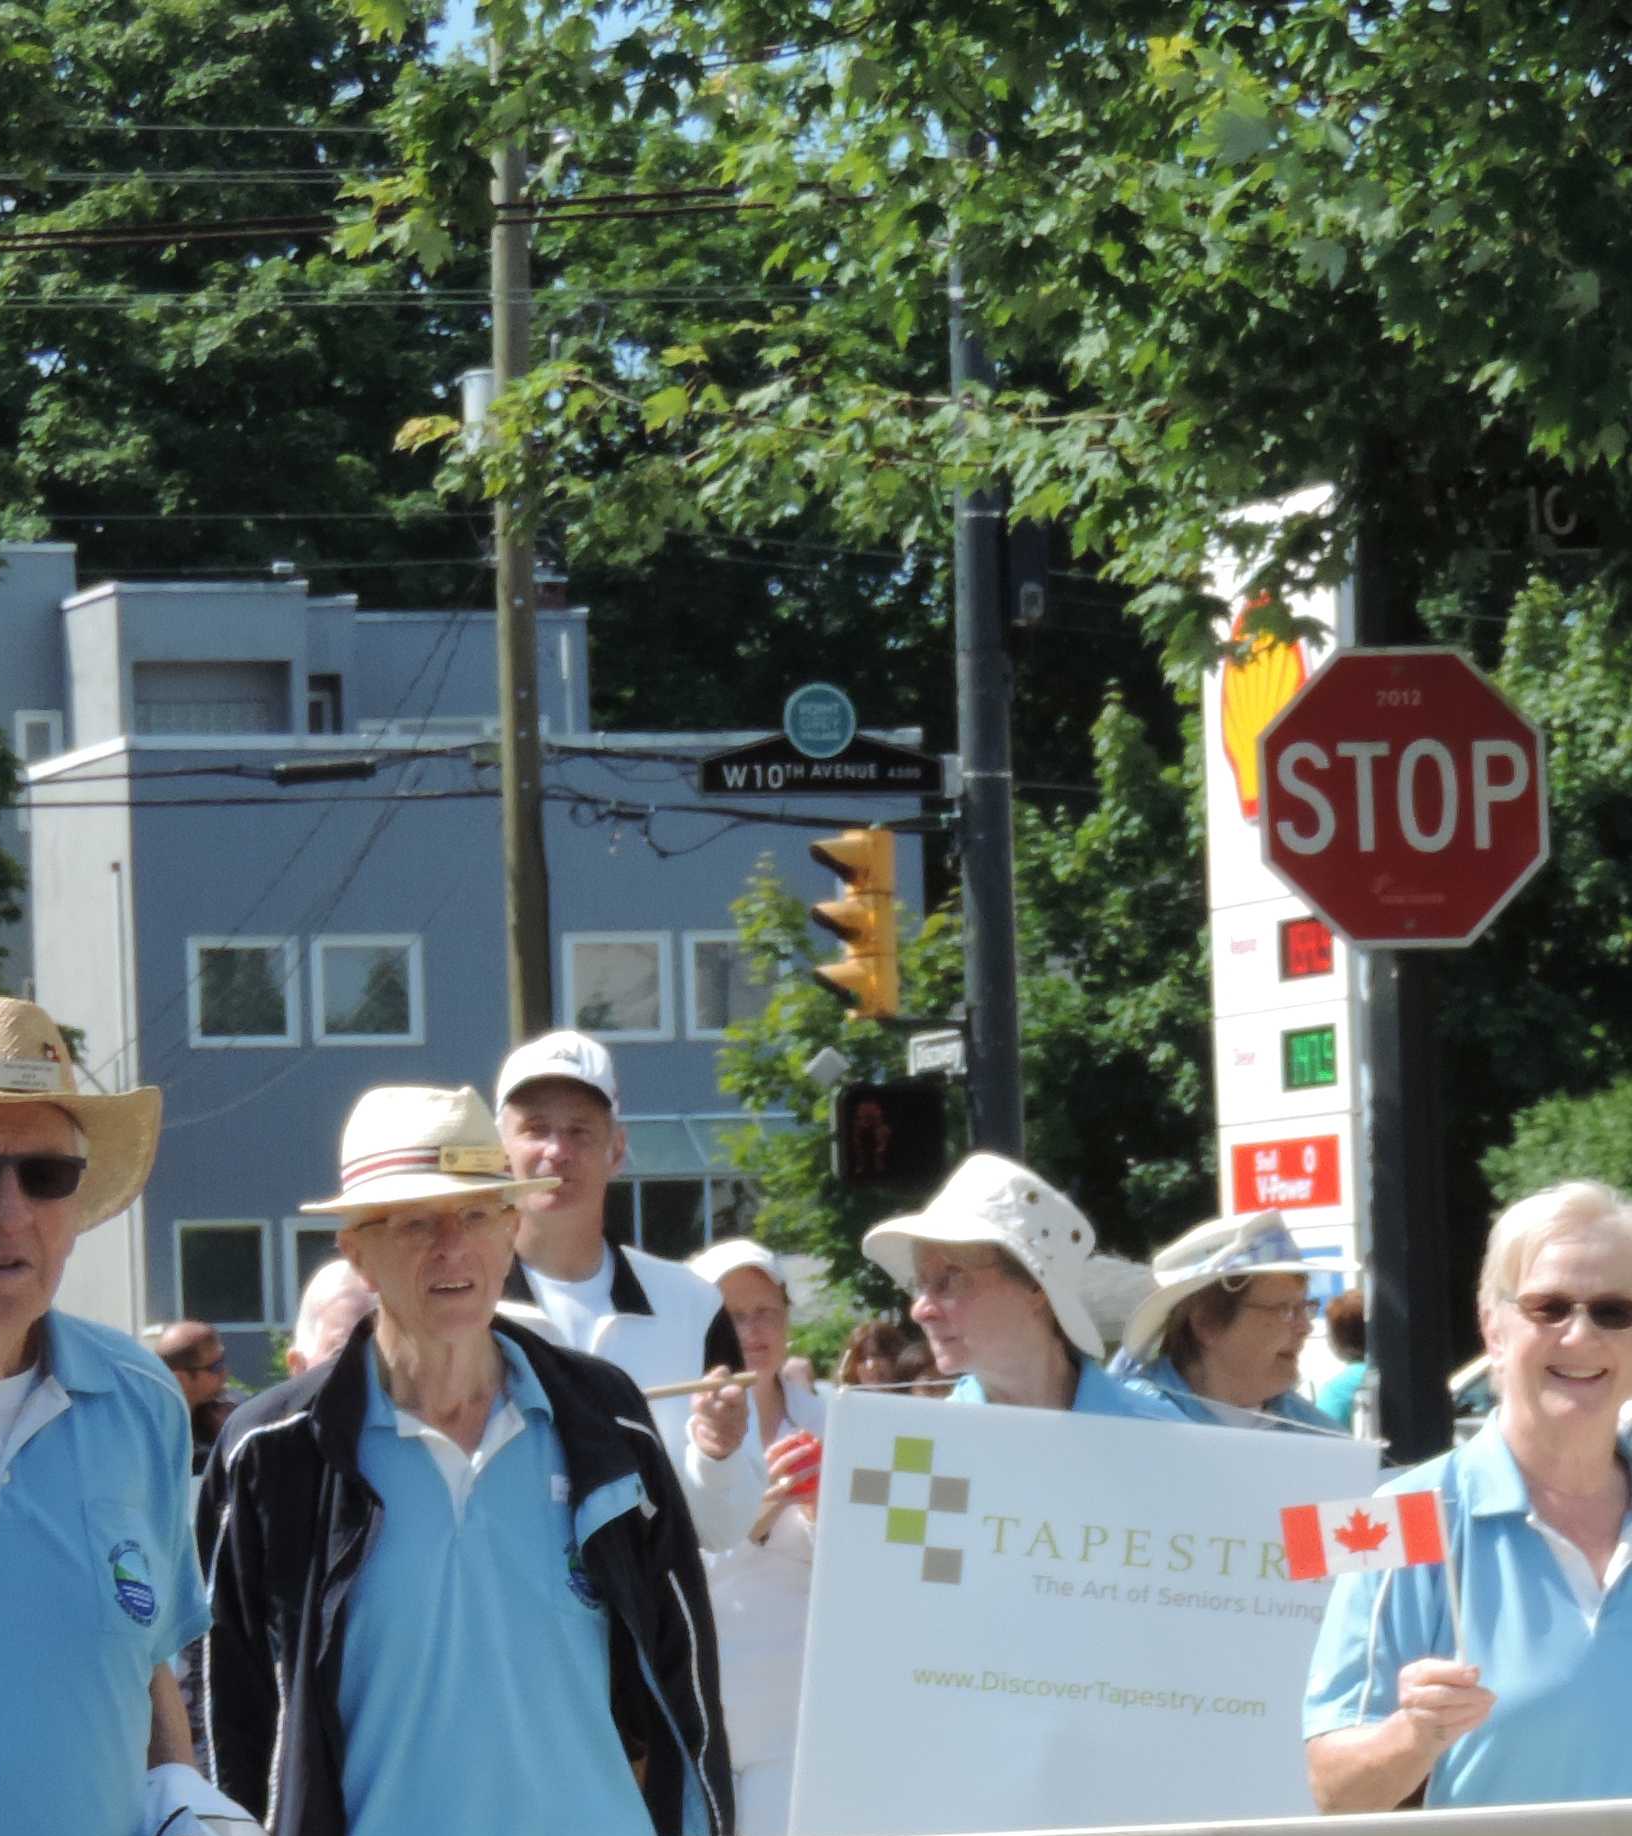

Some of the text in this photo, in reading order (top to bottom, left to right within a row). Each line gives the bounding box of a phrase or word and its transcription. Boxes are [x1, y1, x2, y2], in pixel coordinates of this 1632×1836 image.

[1375, 690, 1422, 706] 2012
[722, 764, 749, 789] W
[809, 763, 879, 779] AVENUE
[1276, 738, 1530, 856] STOP
[983, 1515, 1338, 1583] TAPESTR
[1032, 1574, 1324, 1625] The Art of Seniors Living
[912, 1666, 1267, 1718] www.DiscoverTapestry.com
